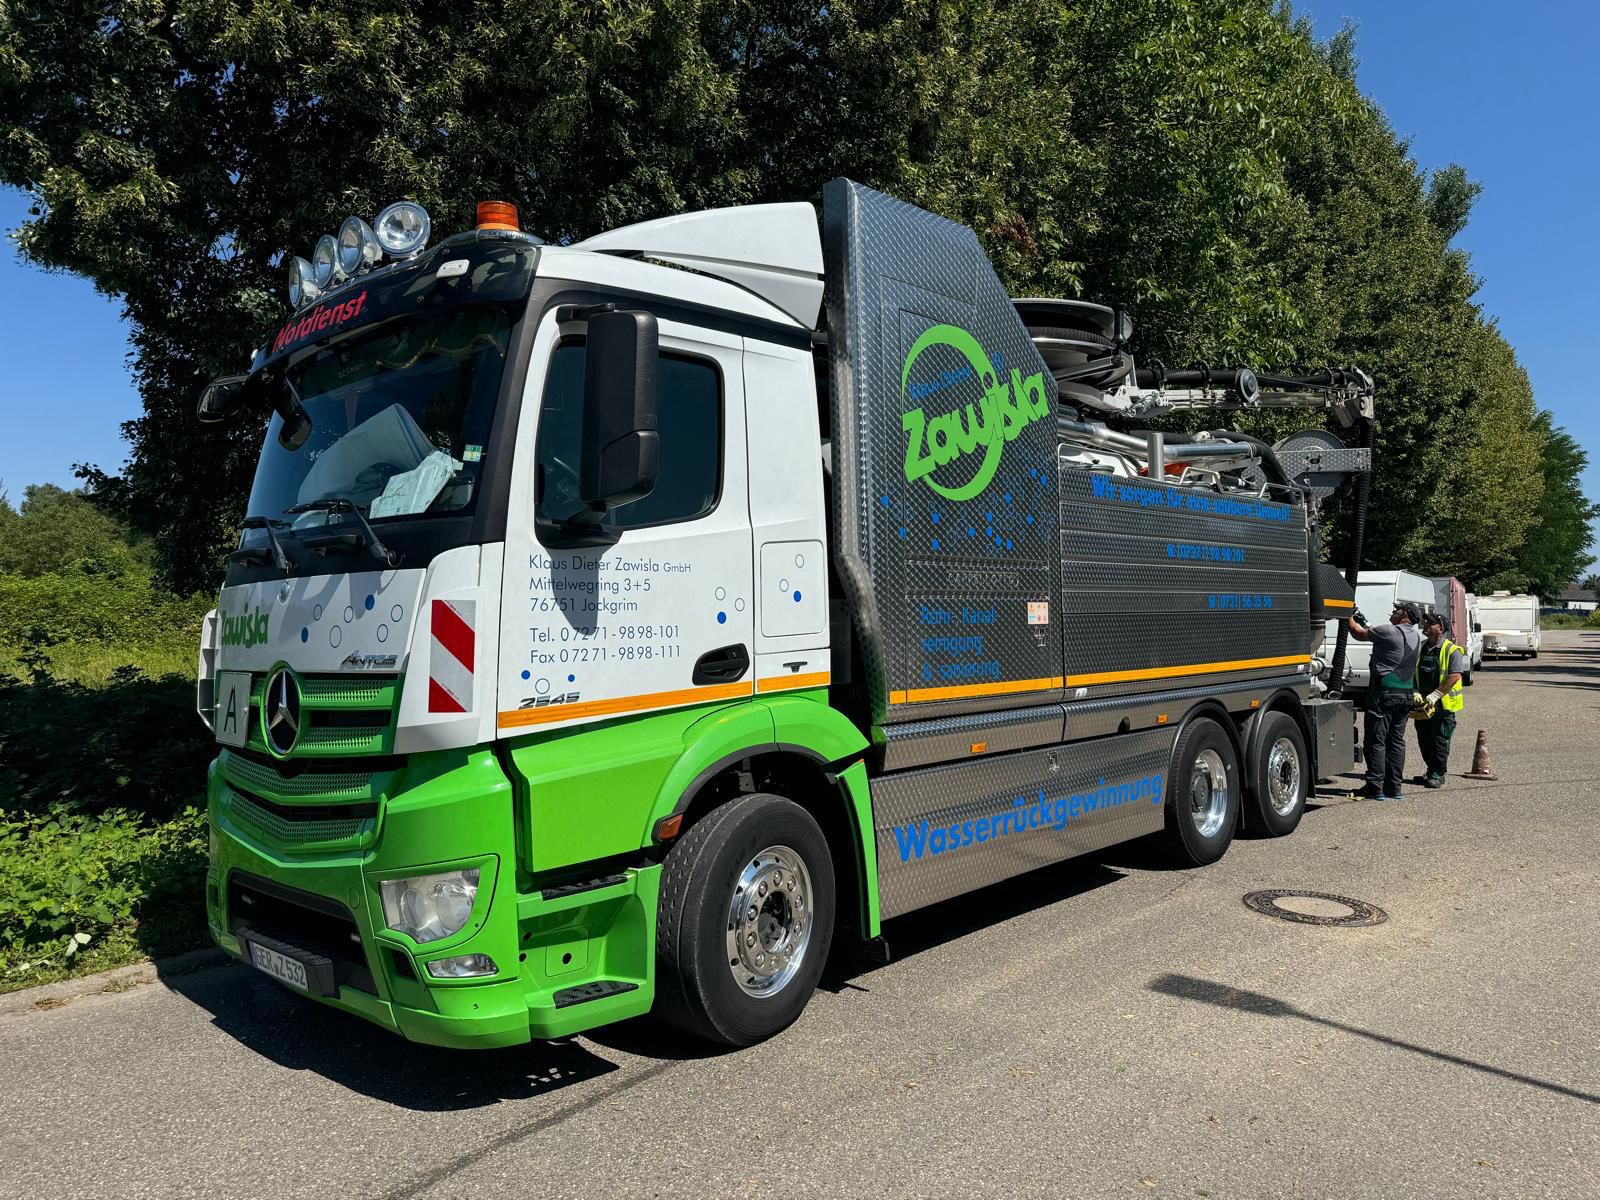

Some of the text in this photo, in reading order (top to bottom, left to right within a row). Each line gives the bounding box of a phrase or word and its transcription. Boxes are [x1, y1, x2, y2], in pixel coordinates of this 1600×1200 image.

[272, 290, 367, 353] Notdienst
[903, 369, 1049, 484] Zawisla
[1091, 473, 1115, 501] Wir
[1120, 485, 1163, 509] sorgen
[1166, 486, 1184, 508] für
[1186, 491, 1210, 512] eine
[1213, 496, 1252, 518] saubere
[529, 554, 691, 574] Klaus Dieter Zawisla GmbH
[529, 576, 651, 594] Mittelwegring 3+5
[530, 597, 638, 615] 76751 Jockgrim
[530, 627, 554, 643] Tel.
[530, 649, 554, 664] Fax
[921, 636, 983, 657] reinigung
[224, 683, 237, 734] A
[519, 691, 580, 709] 2545
[894, 773, 1163, 863] Wasserrückgewinnung
